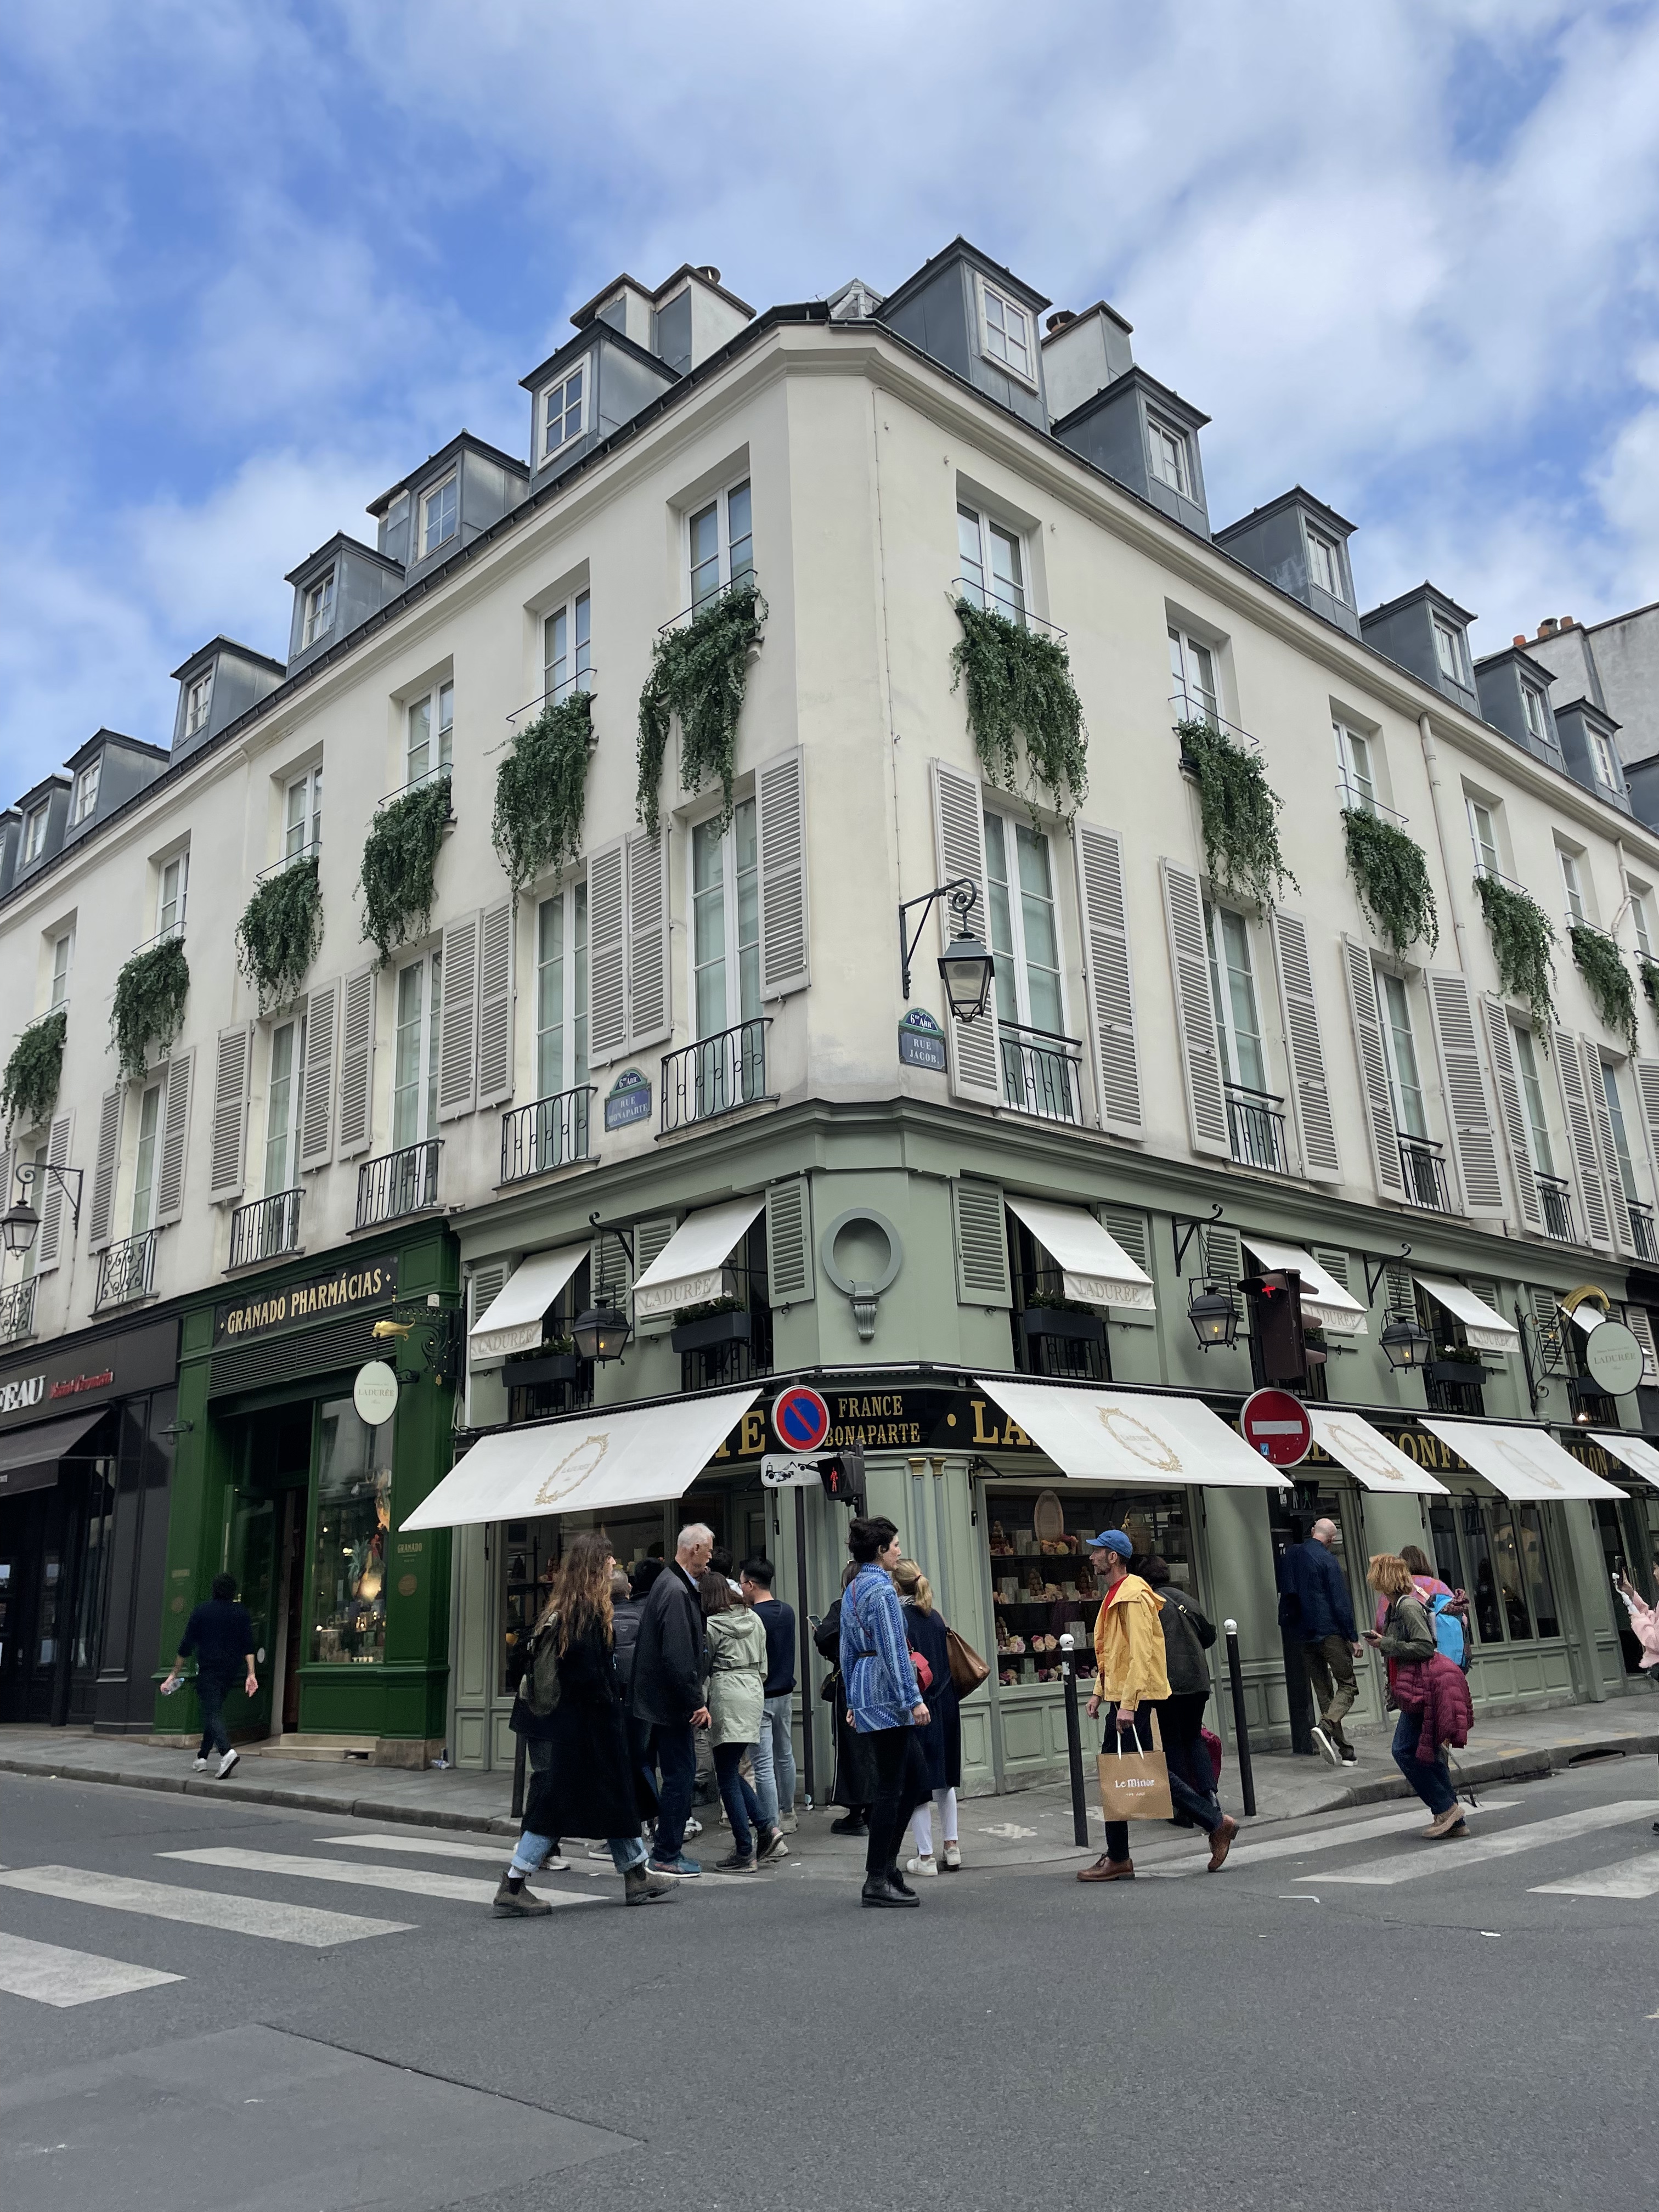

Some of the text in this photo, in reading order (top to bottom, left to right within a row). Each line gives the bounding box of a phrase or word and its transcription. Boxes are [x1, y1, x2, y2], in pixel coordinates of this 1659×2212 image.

[913, 1038, 932, 1051] RUE
[608, 1103, 648, 1123] BONAPARTE
[620, 1096, 635, 1108] RUE
[227, 1268, 382, 1334] GRANADO PHARMÁCIAS
[645, 1278, 712, 1308] LADURÉE
[1077, 1279, 1140, 1302] LADURÉE
[477, 1328, 534, 1353] LADURÉE
[0, 1374, 46, 1413] EAU
[838, 1395, 903, 1418] FRANCE
[824, 1423, 920, 1446] BONAPARTE
[1115, 1779, 1155, 1788] Le Minor
